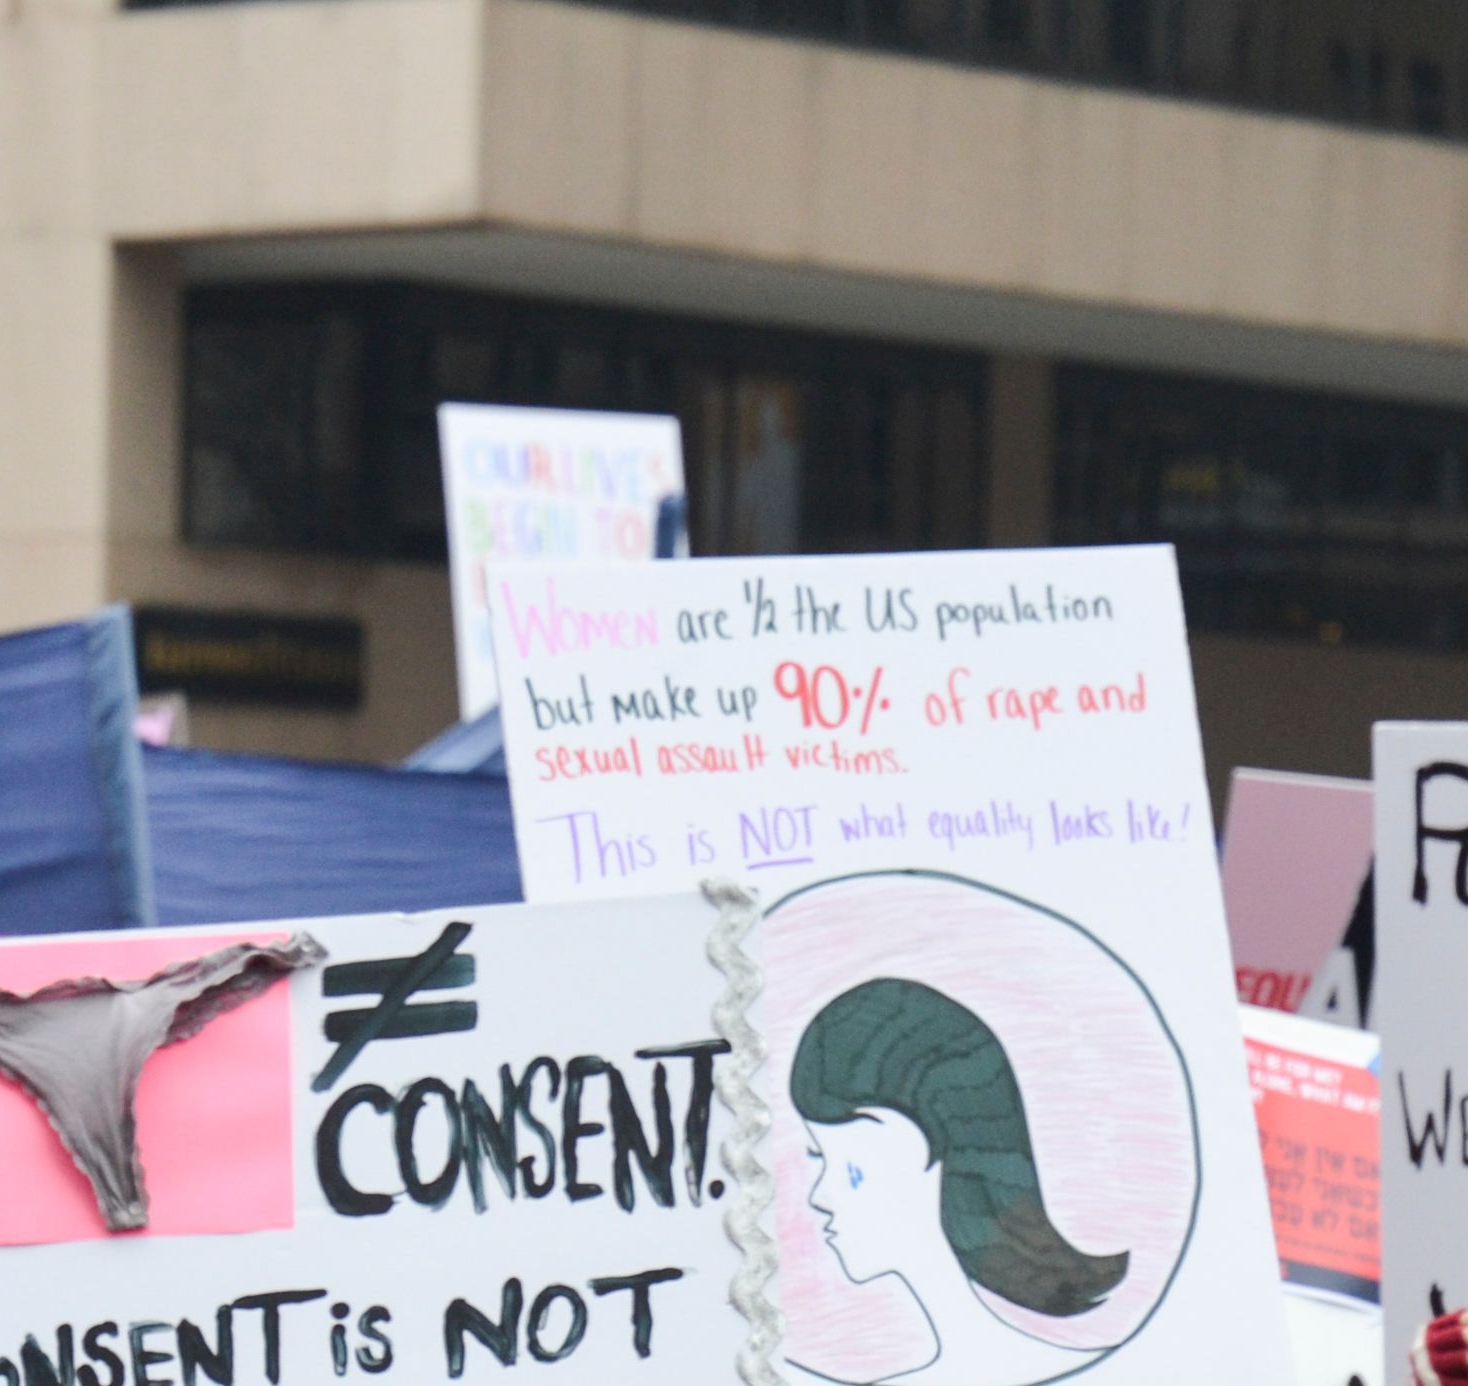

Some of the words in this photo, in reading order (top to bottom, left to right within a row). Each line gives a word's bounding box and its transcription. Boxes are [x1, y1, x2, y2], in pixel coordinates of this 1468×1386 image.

[678, 605, 732, 642] are
[794, 584, 846, 635] the
[866, 589, 918, 633] US
[937, 582, 1114, 649] population
[524, 677, 595, 730] but
[718, 691, 757, 732] up
[773, 661, 890, 735] 90%
[925, 668, 972, 727] of
[989, 682, 1062, 732] rape
[1079, 672, 1146, 714] and
[536, 736, 643, 781] sexual
[658, 734, 765, 775] assault
[786, 739, 908, 775] victims.
[537, 810, 656, 885] This
[688, 824, 714, 865] is
[741, 805, 818, 860] NOT
[841, 802, 908, 844] what
[929, 800, 1034, 862] equality
[1051, 800, 1114, 844] looks
[1128, 800, 1193, 844] like!
[444, 1267, 685, 1377] NOT
